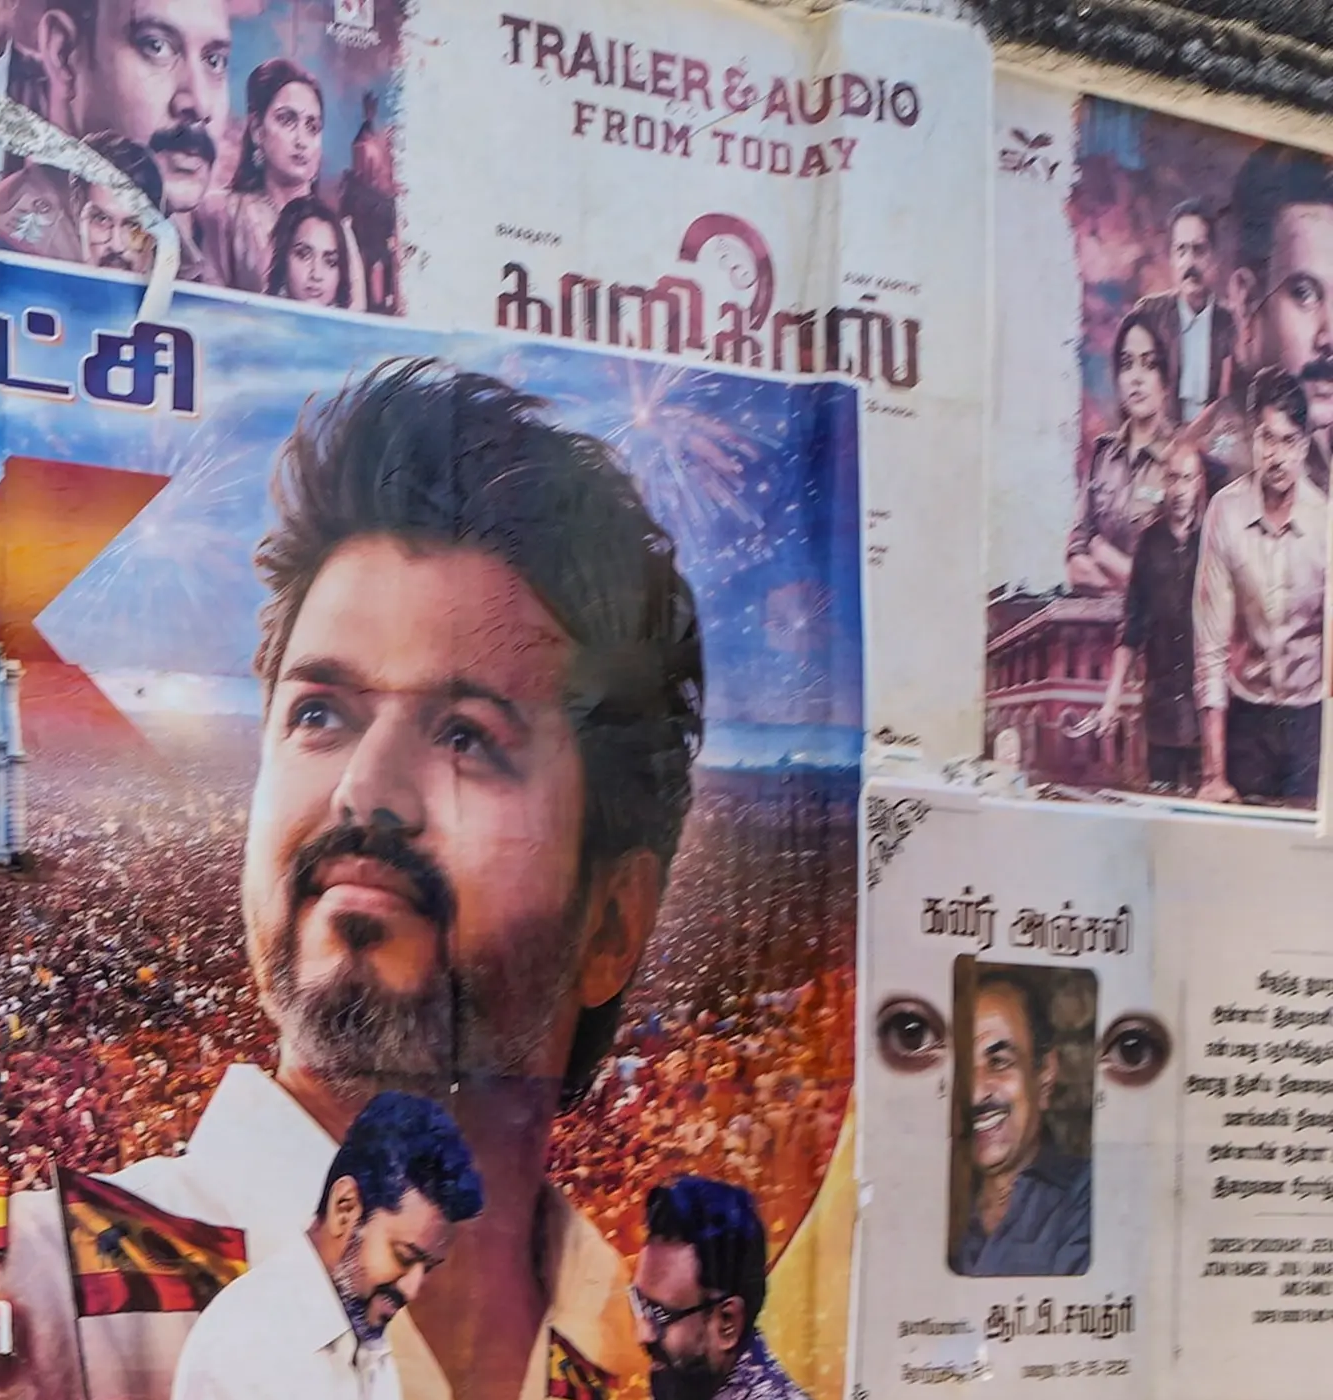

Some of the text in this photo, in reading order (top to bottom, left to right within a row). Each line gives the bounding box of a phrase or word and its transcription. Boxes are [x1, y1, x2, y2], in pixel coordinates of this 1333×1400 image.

[500, 14, 921, 127] TRAILER & AUDIO
[571, 100, 859, 179] FROM TODAY
